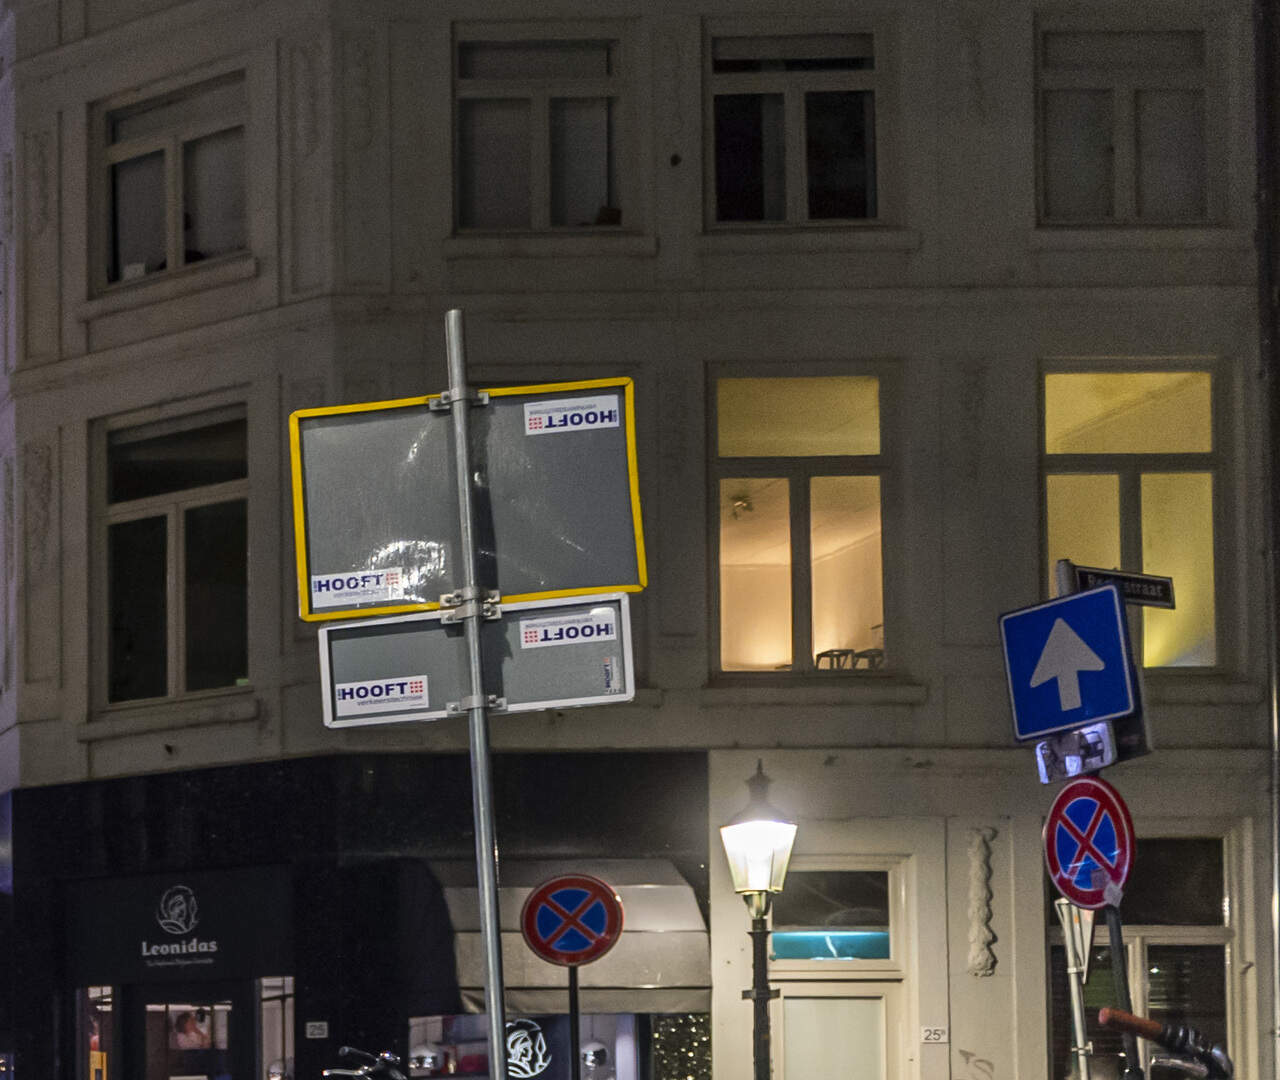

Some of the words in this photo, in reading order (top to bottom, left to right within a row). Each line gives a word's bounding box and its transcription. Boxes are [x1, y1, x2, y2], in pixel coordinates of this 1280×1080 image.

[544, 409, 614, 429] HOOFT
[316, 573, 385, 593] HOOFT
[539, 622, 610, 642] HOOFT
[341, 681, 409, 701] HOOFT
[141, 937, 218, 956] Leonidas
